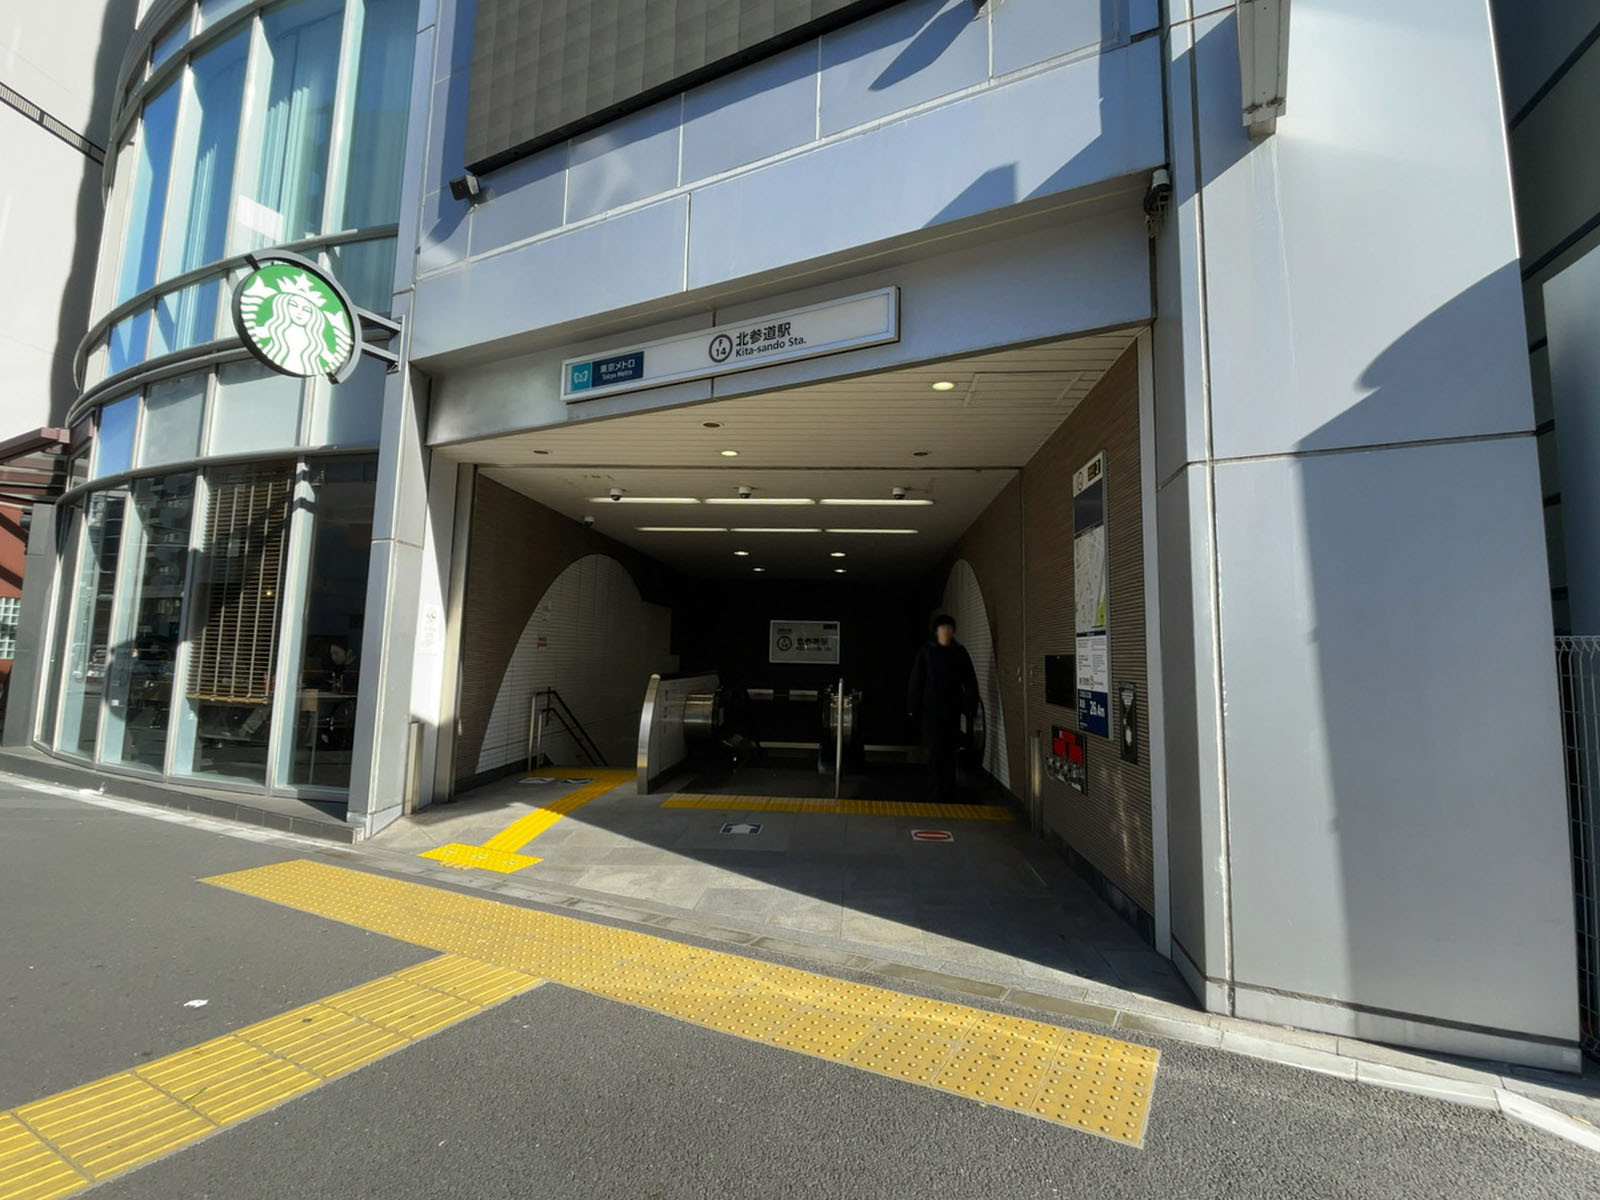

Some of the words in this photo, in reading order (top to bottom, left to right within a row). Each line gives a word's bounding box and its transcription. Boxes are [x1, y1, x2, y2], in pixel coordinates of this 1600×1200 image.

[736, 321, 791, 347] 北参道駅
[715, 347, 727, 357] 14
[735, 340, 786, 358] Kita-sando
[788, 336, 807, 347] Sta.
[600, 359, 635, 373] 東京メトロ
